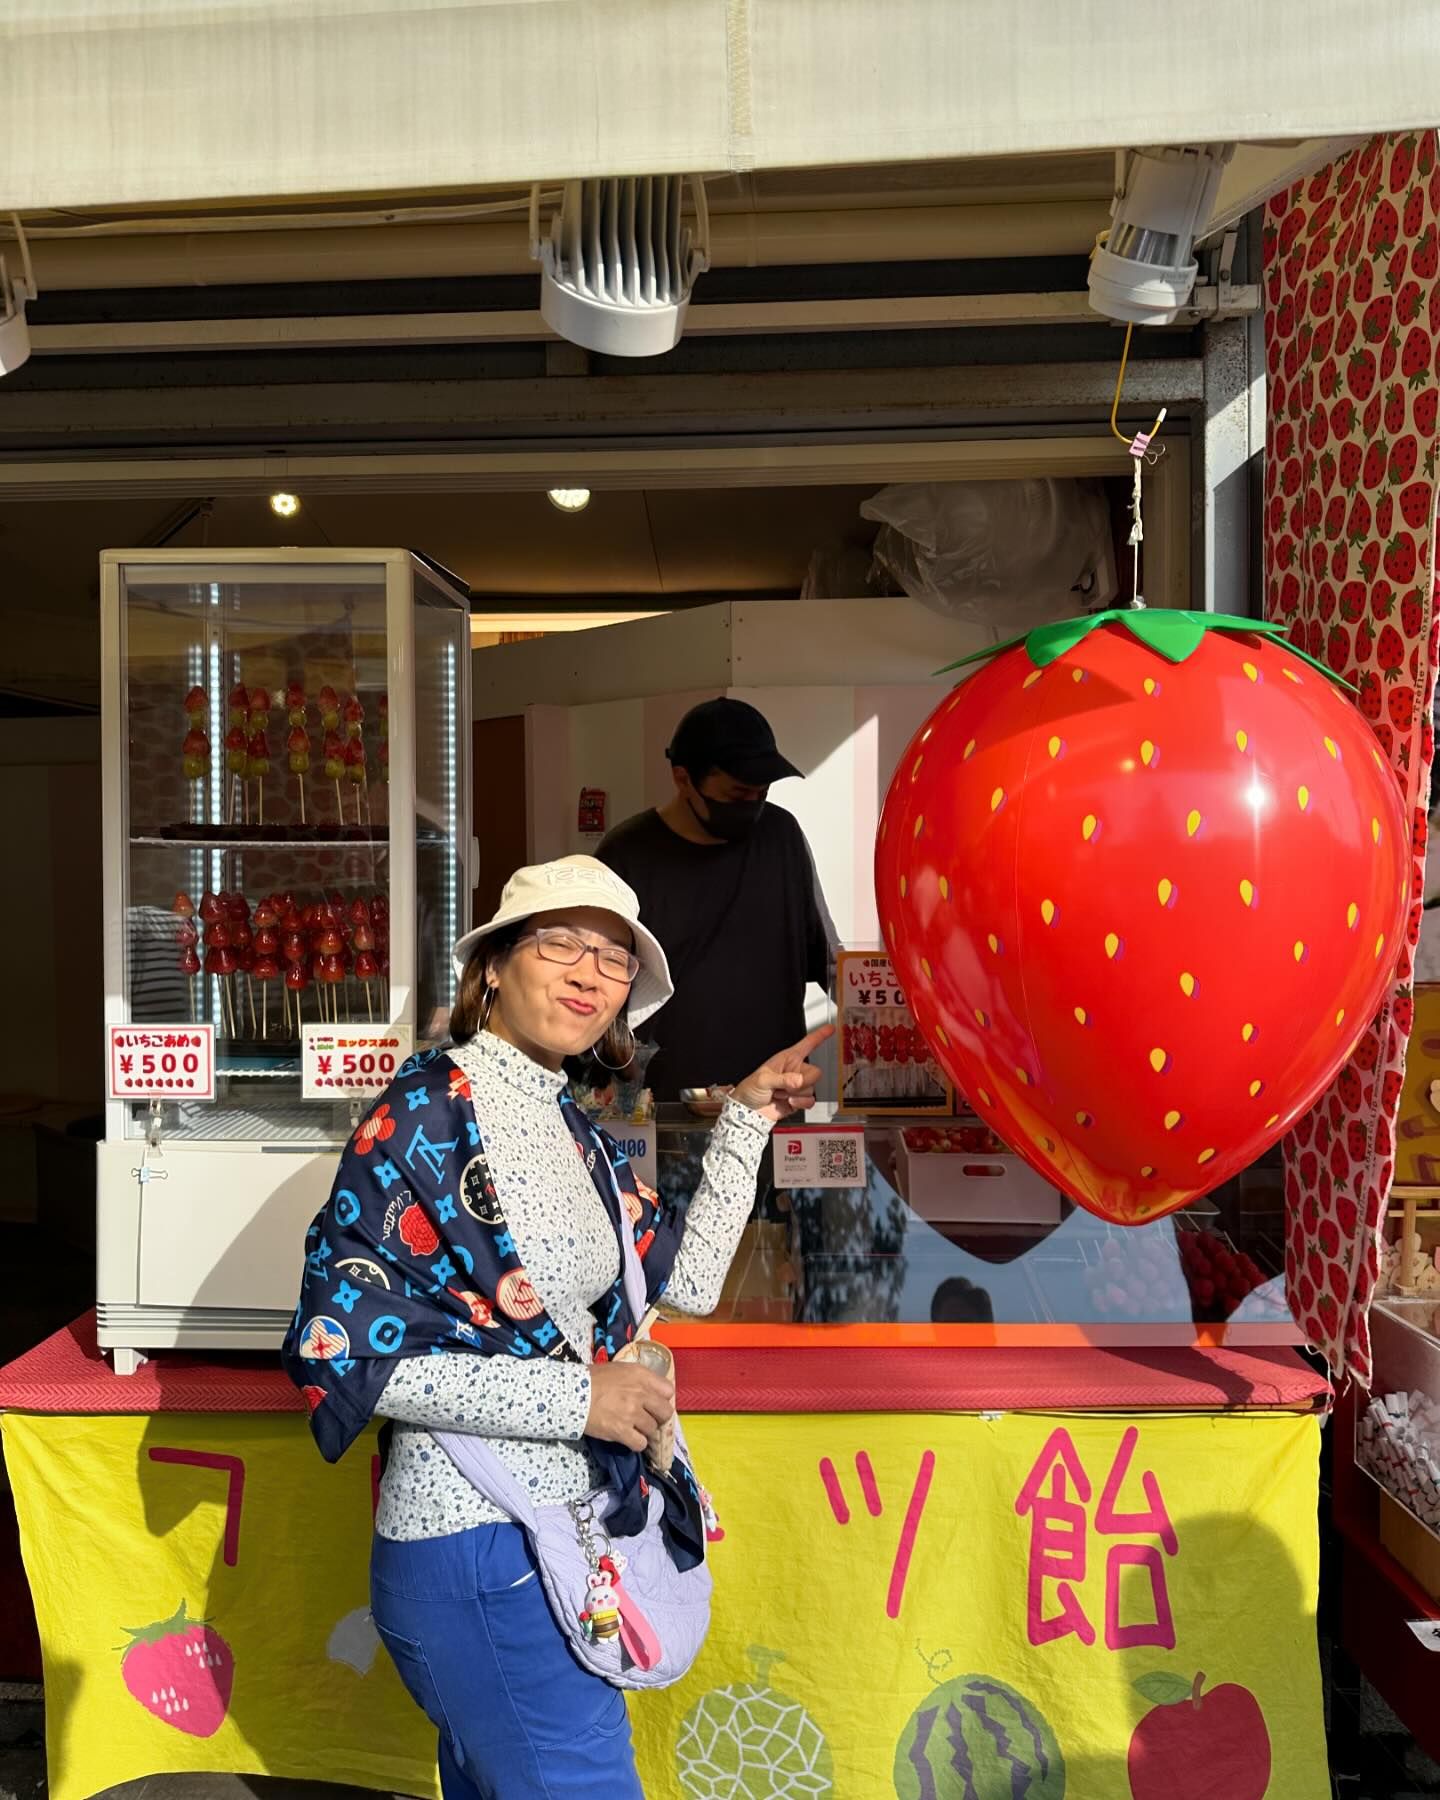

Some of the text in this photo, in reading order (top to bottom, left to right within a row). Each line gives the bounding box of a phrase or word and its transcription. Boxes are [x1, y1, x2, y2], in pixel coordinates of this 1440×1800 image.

[126, 1034, 190, 1048] いちごあめ
